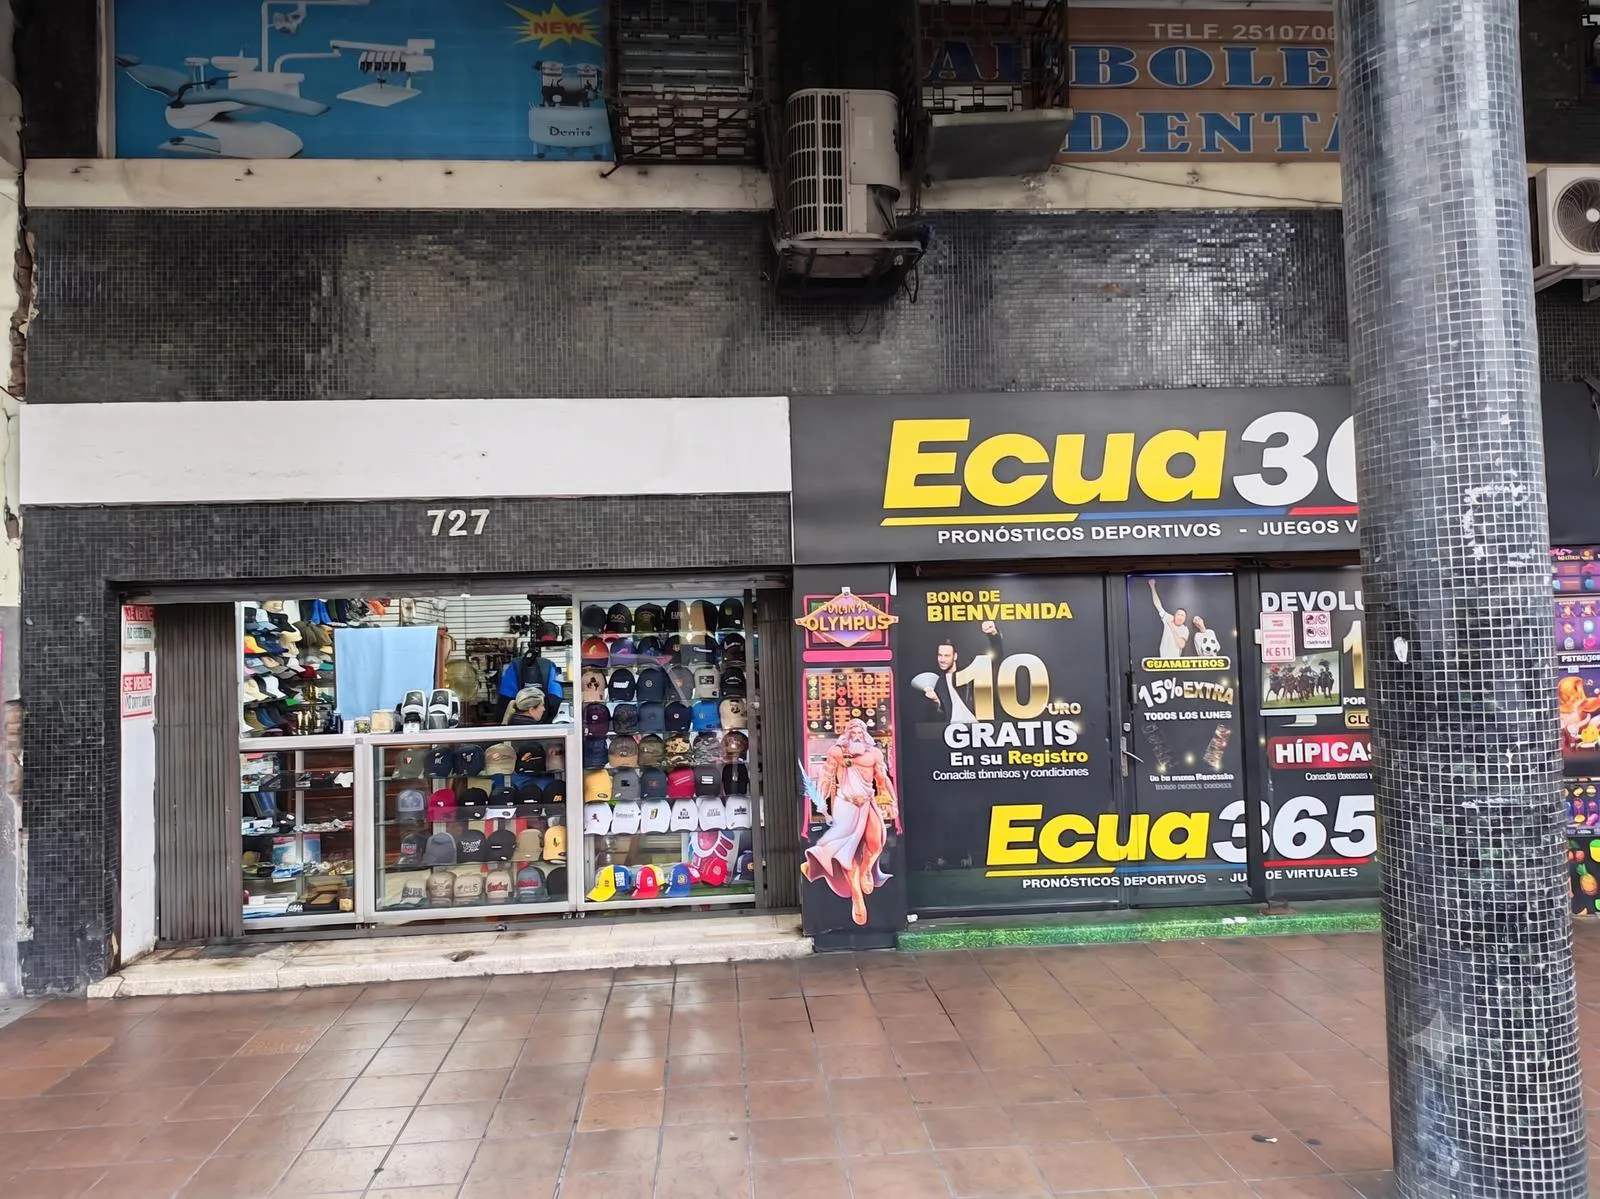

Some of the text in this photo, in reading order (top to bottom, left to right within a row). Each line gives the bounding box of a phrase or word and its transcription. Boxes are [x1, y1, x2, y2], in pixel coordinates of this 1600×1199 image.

[531, 22, 584, 35] NEW
[1148, 23, 1223, 40] TELF.
[427, 508, 490, 537] 727
[938, 525, 1084, 545] PRONÓSTICOS
[1090, 522, 1222, 542] DEPORTIVOS
[1258, 520, 1339, 536] JUEGOS
[926, 590, 1001, 604] BONO DE
[927, 602, 1073, 622] BIENVENIDA
[807, 614, 889, 632] OLYMPUS
[955, 653, 1050, 721] 10
[1183, 681, 1234, 705] EXTRA
[1343, 696, 1366, 705] POR
[1144, 710, 1232, 721] TODOS LOS LUNES
[943, 719, 1078, 749] GRATIS
[950, 749, 1089, 768] En su Registro
[1030, 766, 1090, 778] condiciones
[986, 794, 1378, 866] Ecua365
[1022, 874, 1120, 889] PRONÓSTICOS
[1124, 873, 1207, 887] DEPORTIVOS
[1285, 867, 1358, 879] VIRTUALES
